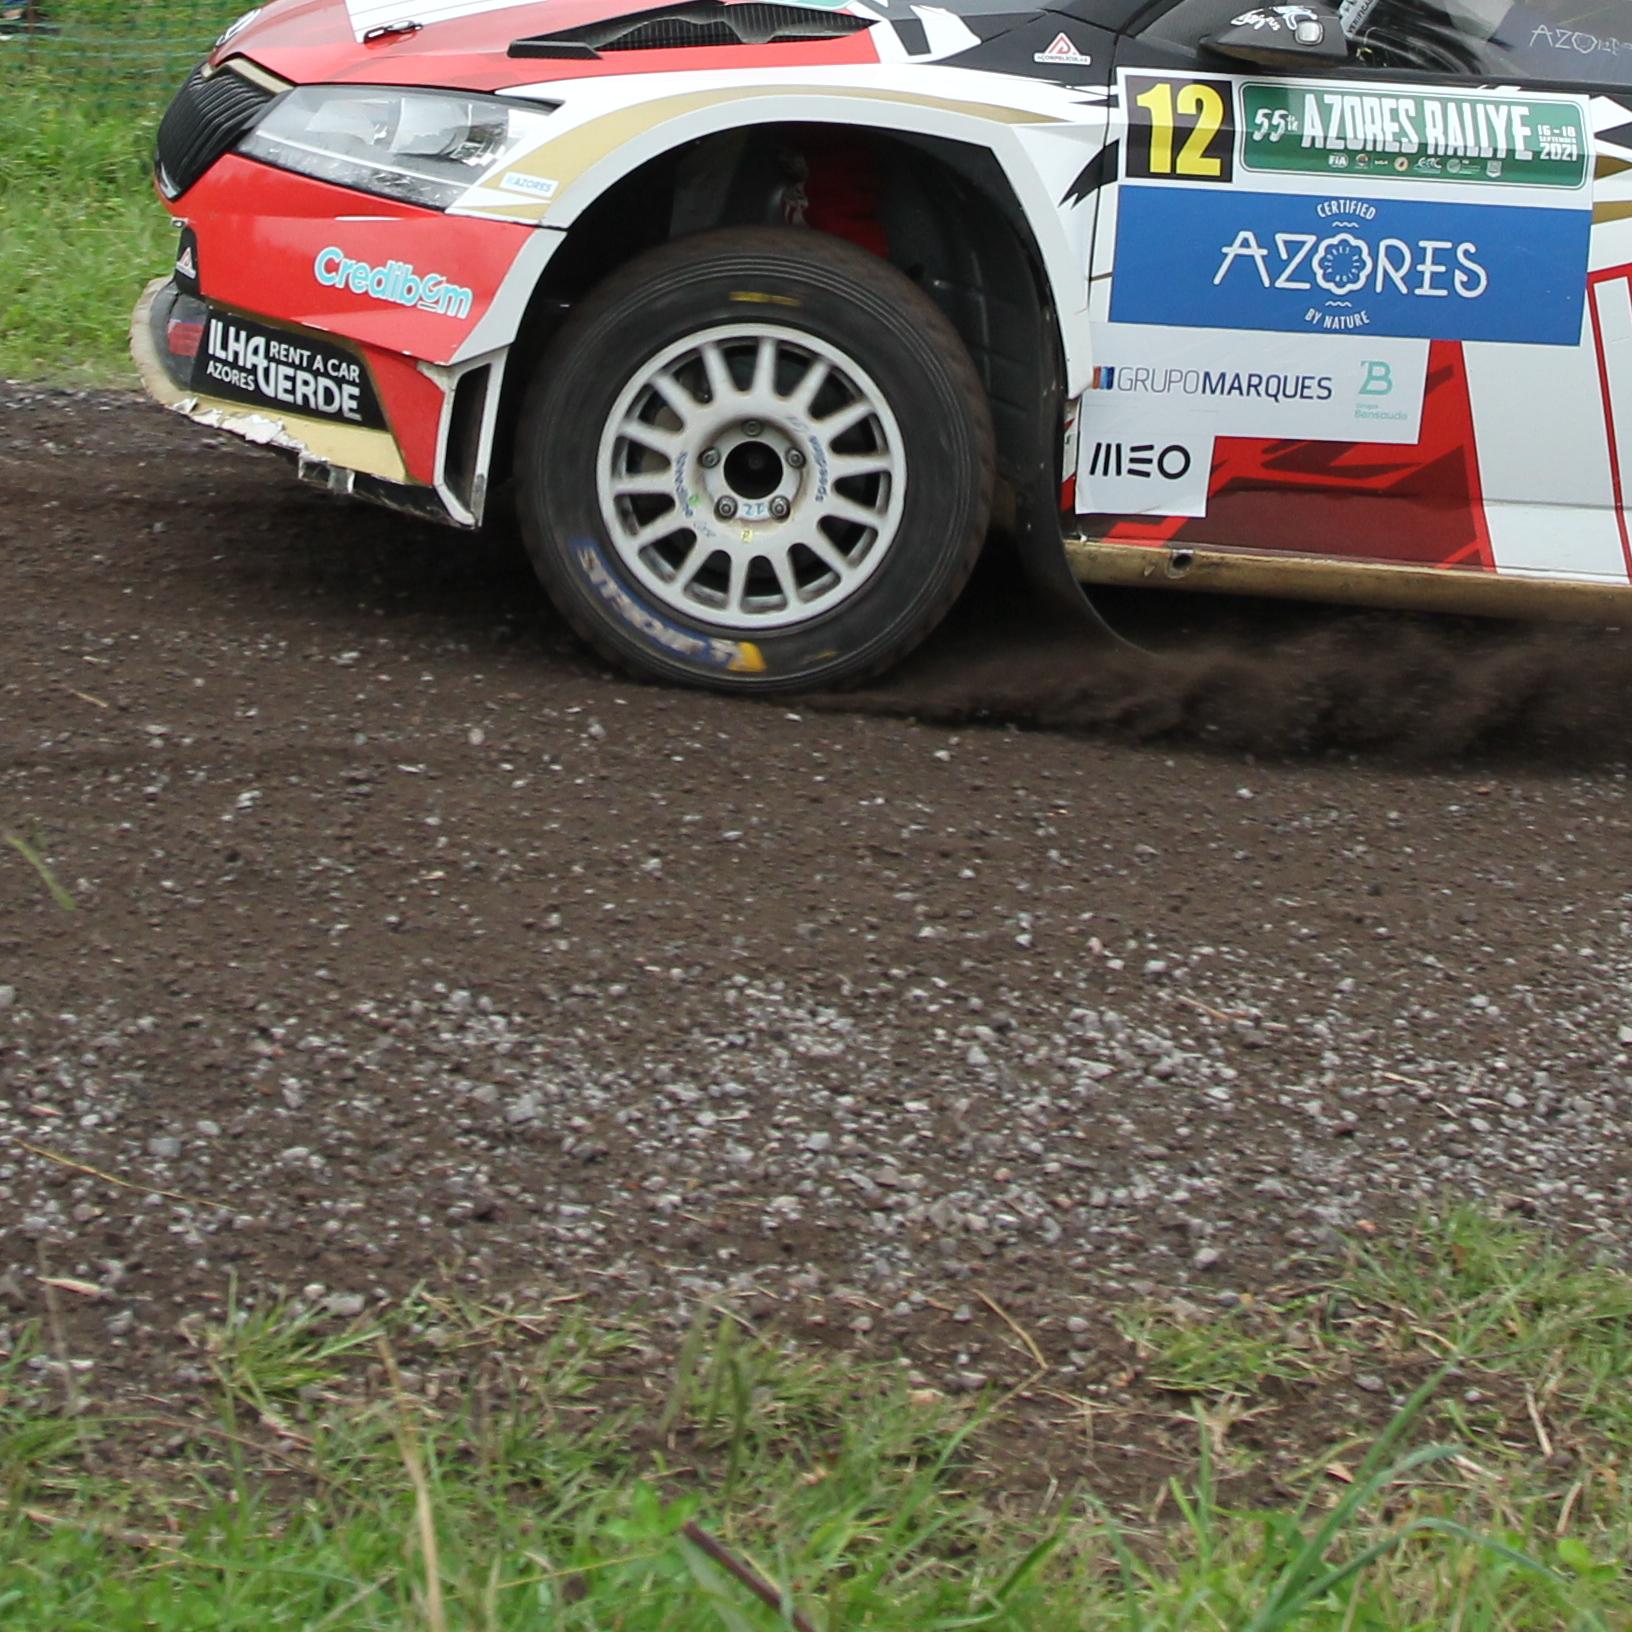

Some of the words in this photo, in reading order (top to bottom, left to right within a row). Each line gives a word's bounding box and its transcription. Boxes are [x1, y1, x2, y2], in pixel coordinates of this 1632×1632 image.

[1137, 82, 1225, 176] 12
[1300, 93, 1419, 153] AZORES
[1425, 100, 1534, 161] RALLYE
[1328, 154, 1348, 167] FIA
[1539, 143, 1578, 161] 2021
[1316, 199, 1377, 220] CERTIFIED
[314, 247, 474, 320] Credibom
[1212, 231, 1488, 298] AZORES
[1305, 308, 1323, 325] BY
[1323, 310, 1370, 330] NATURE
[208, 319, 267, 370] ILHA
[269, 341, 311, 367] RENT
[313, 354, 325, 372] A
[327, 359, 361, 383] CAR
[207, 360, 256, 391] AZORES
[1089, 442, 1191, 480] MEO
